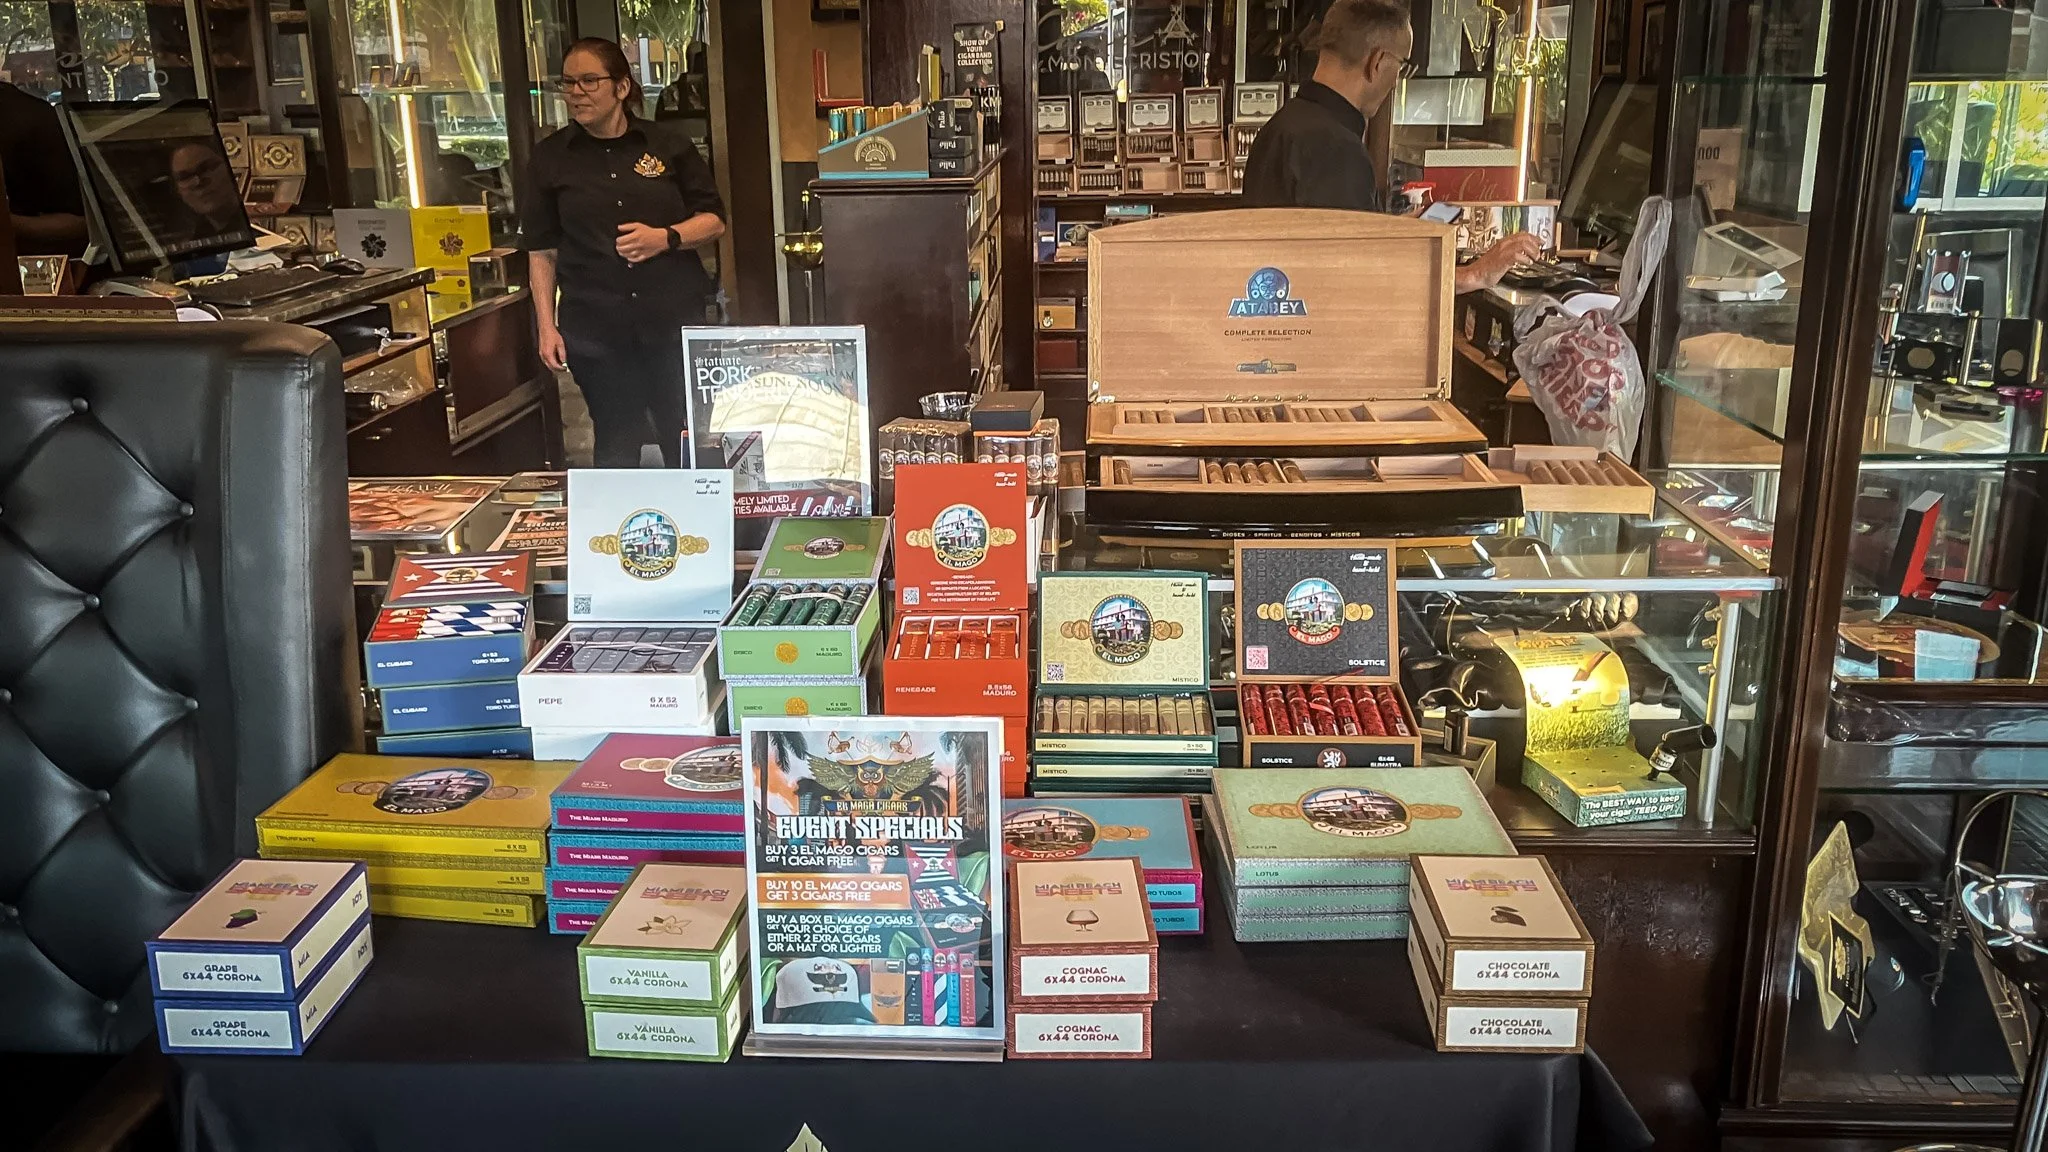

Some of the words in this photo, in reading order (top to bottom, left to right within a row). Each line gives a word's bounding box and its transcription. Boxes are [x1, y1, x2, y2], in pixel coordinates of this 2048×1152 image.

[1050, 52, 1199, 72] MONECRISTO
[1237, 302, 1300, 314] ATABEY
[697, 366, 751, 386] PORK
[756, 494, 789, 505] LIMITED
[753, 502, 797, 514] AVAILABLE
[943, 557, 953, 567] EL
[954, 557, 978, 568] MAGO
[630, 567, 640, 577] EL
[641, 567, 667, 579] MAGO
[1296, 633, 1306, 642] EL
[1308, 633, 1333, 643] MAGO
[1102, 652, 1112, 662] EL
[1114, 652, 1141, 664] MAGO
[538, 697, 563, 705] PEPE
[679, 779, 694, 788] EL
[697, 782, 741, 790] MAGO
[1585, 801, 1601, 810] The
[1602, 799, 1625, 808] BEST
[1626, 797, 1646, 806] WAY
[1659, 794, 1680, 804] keep
[383, 804, 398, 813] EL
[400, 805, 447, 815] MAGO
[1590, 810, 1609, 819] your
[1610, 808, 1632, 818] cigar
[1634, 806, 1657, 815] TEED
[1658, 804, 1674, 813] UP!
[777, 816, 852, 839] EVENT
[855, 816, 963, 840] SPECIALS
[1328, 827, 1344, 835] EL
[1352, 828, 1395, 837] MAGO
[766, 845, 788, 855] BUY
[791, 845, 798, 855] 3
[800, 845, 813, 855] EL
[815, 845, 854, 856] MAGO
[856, 845, 900, 856] CIGARS
[1010, 850, 1028, 858] EL
[1032, 849, 1077, 859] MAGO
[781, 857, 786, 866] 1
[788, 856, 824, 866] CIGAR
[827, 856, 853, 866] FREE
[766, 881, 788, 890] BUY
[791, 880, 802, 890] 10
[805, 881, 818, 890] EL
[820, 881, 858, 890] MAGO
[860, 881, 903, 891] CIGARS
[766, 891, 789, 900] GET
[791, 891, 798, 900] 3
[800, 891, 843, 901] CIGARS
[844, 891, 871, 901] FREE
[766, 915, 788, 924] BUY
[789, 915, 798, 924] A
[800, 915, 822, 924] BOX
[824, 915, 836, 924] EL
[838, 915, 872, 925] MAGO
[874, 915, 913, 925] CIGARS
[781, 924, 811, 934] YOUR
[813, 925, 852, 934] CHOICE
[854, 925, 869, 934] OF
[767, 933, 801, 943] EITHER
[804, 934, 811, 943] 2
[812, 934, 840, 943] EXRA
[842, 934, 881, 944] CIGARS
[767, 943, 784, 952] OR
[786, 943, 796, 952] A
[797, 943, 818, 952] HAT
[821, 943, 838, 953] OR
[840, 944, 882, 953] LIGHTER
[204, 964, 238, 973] GRAPE
[1062, 967, 1108, 975] COGNAC
[1488, 962, 1550, 970] CHOCOLATE
[183, 972, 213, 980] 6X44
[216, 973, 262, 982] CORONA
[627, 968, 669, 979] VANILLA
[1476, 971, 1509, 979] 6X44
[1514, 971, 1560, 979] CORONA
[609, 976, 640, 986] 6X44
[643, 978, 689, 988] CORONA
[1044, 975, 1076, 984] 6X44
[1080, 975, 1126, 984] CORONA
[212, 1021, 247, 1029] GRAPE
[1480, 1019, 1543, 1027] CHOCOLATE
[191, 1028, 222, 1037] 6X44
[225, 1029, 270, 1038] CORONA
[634, 1025, 676, 1034] VANILLA
[1056, 1025, 1102, 1033] COGNAC
[1469, 1027, 1501, 1035] 6X44
[1505, 1027, 1552, 1035] CORONA
[617, 1032, 647, 1042] 6X44
[651, 1034, 696, 1044] CORONA
[1038, 1033, 1070, 1042] 6X44
[1074, 1033, 1120, 1042] CORONA
